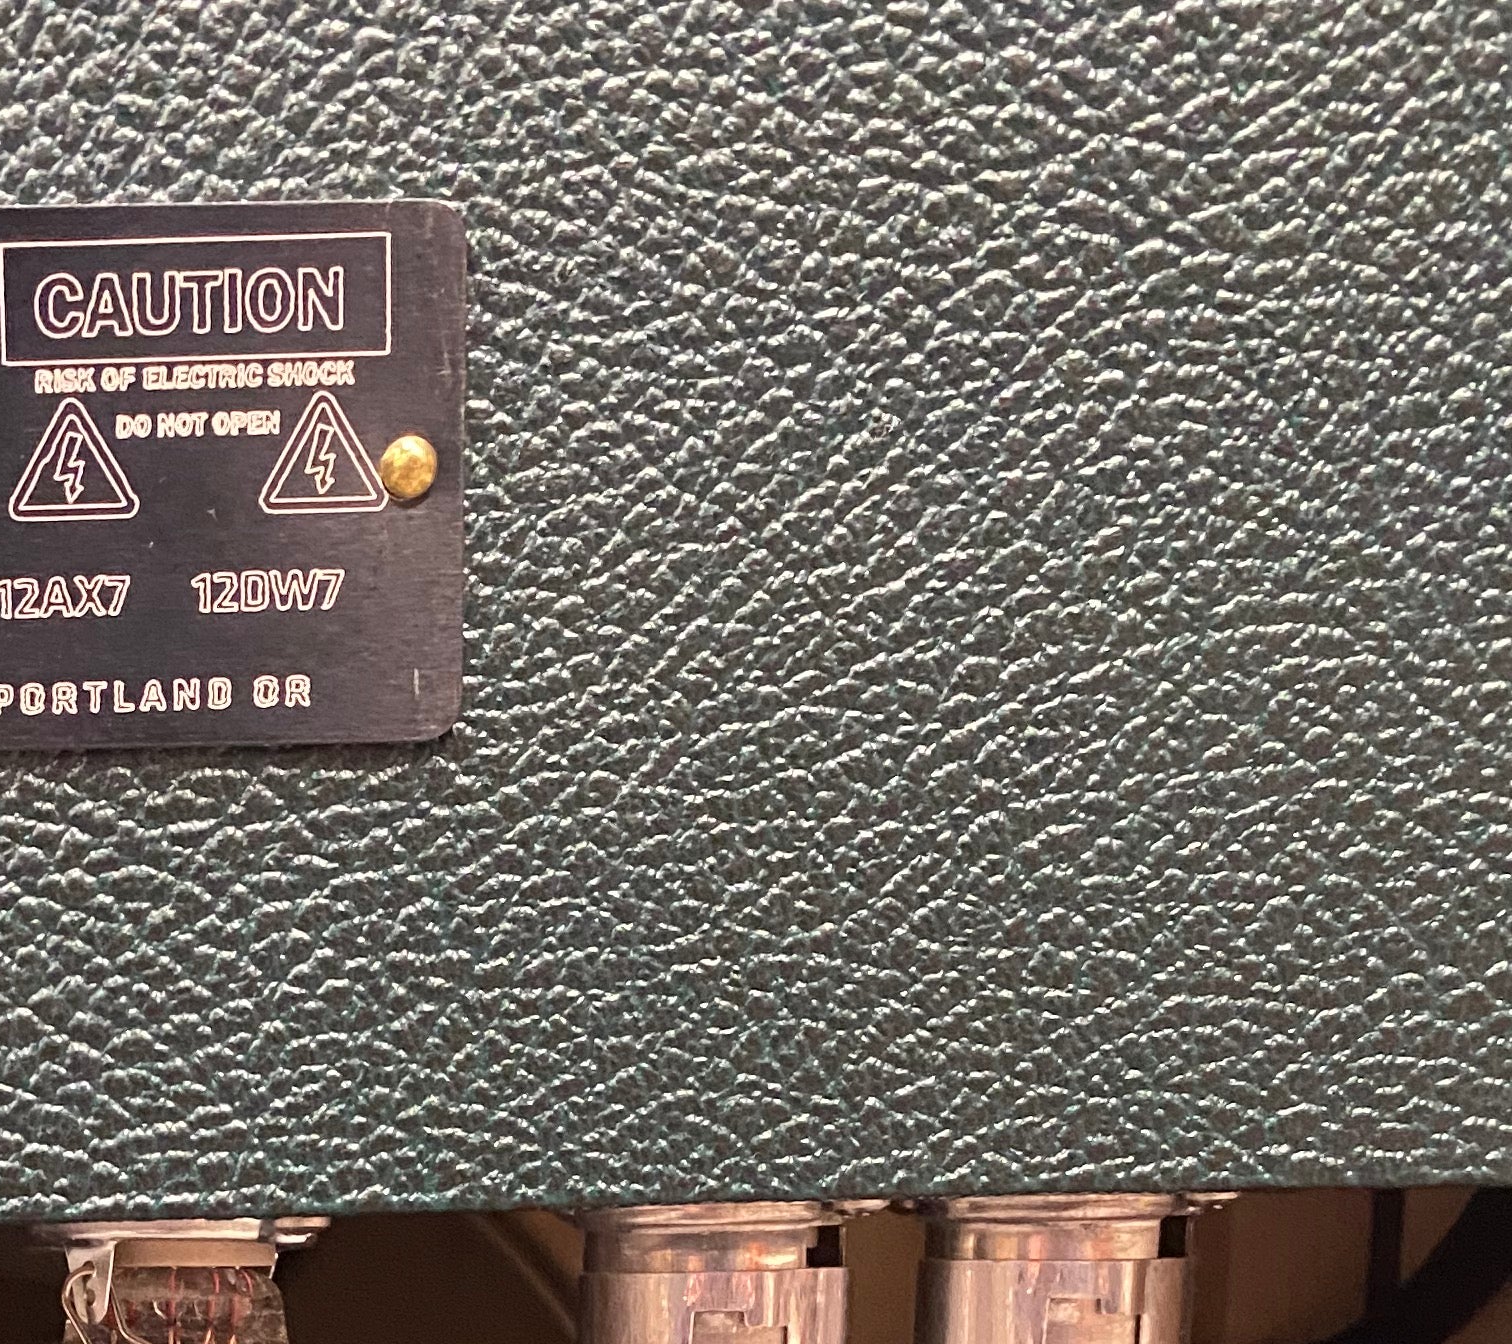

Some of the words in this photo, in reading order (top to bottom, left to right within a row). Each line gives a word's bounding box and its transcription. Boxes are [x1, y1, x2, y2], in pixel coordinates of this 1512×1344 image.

[34, 266, 345, 339] CAUTION
[34, 366, 94, 393] RISK
[100, 366, 136, 391] OF
[142, 363, 263, 389] ELECTRIC
[266, 360, 356, 386] SHOCK
[115, 414, 152, 439] DO
[157, 412, 209, 438] NOT
[212, 409, 281, 436] OPEN
[190, 568, 345, 614] 12DW7
[252, 673, 311, 708] OR
